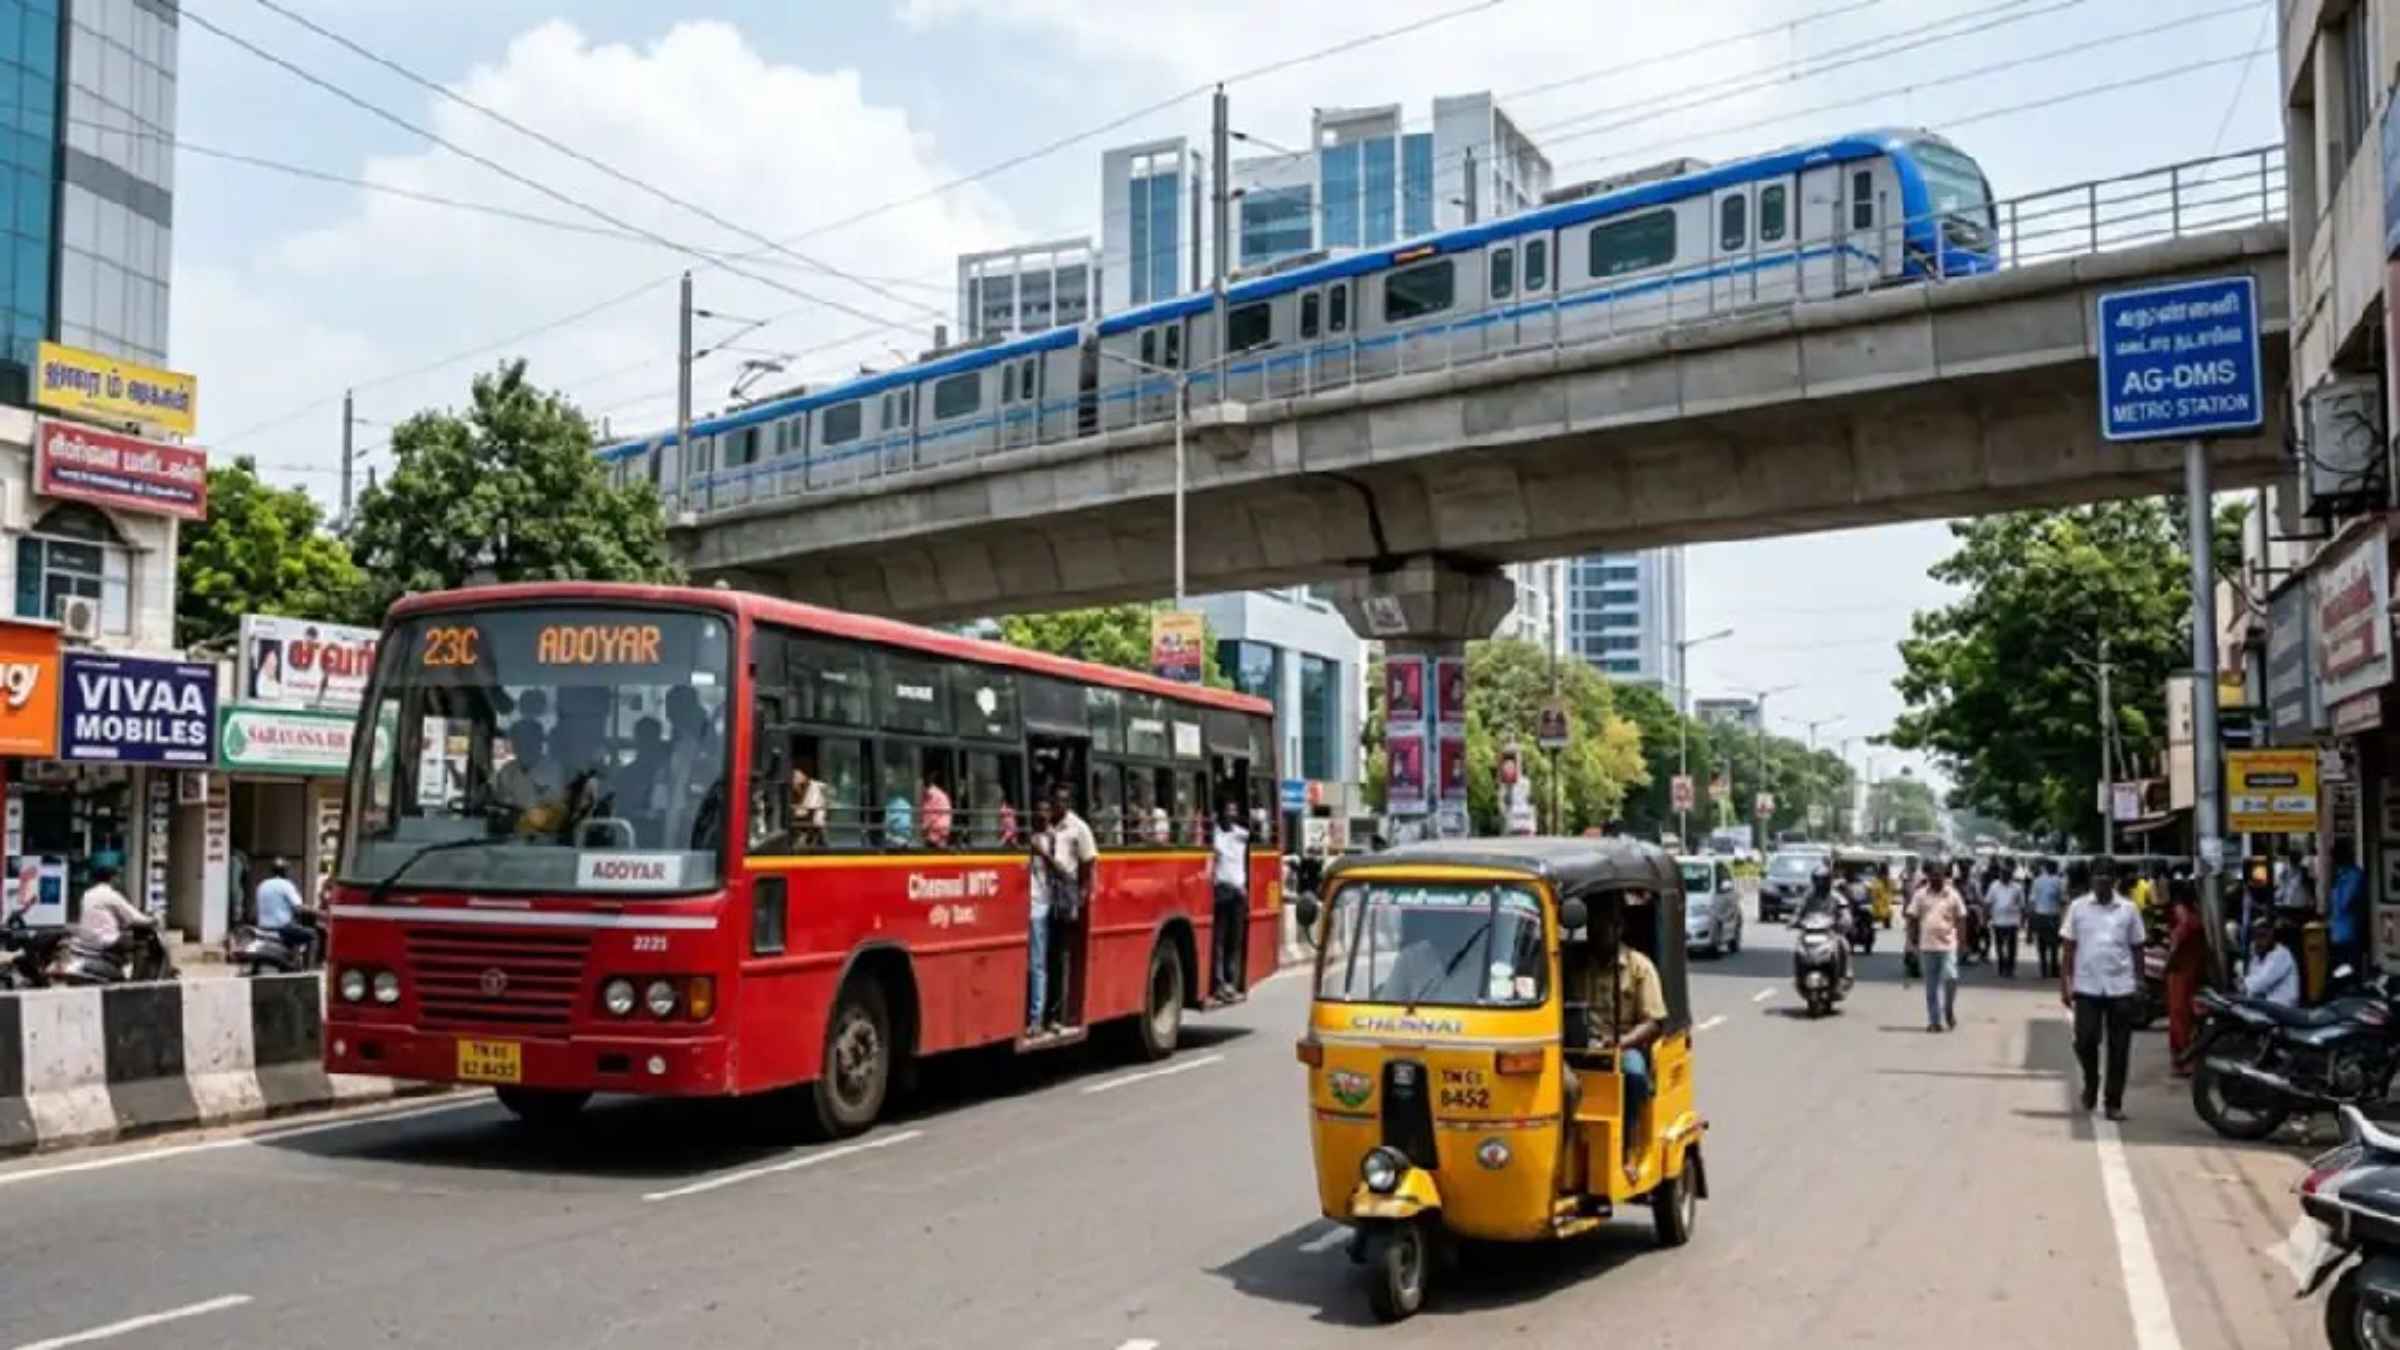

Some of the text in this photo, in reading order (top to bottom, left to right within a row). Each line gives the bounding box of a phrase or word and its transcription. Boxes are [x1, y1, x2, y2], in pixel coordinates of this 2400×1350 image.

[2122, 359, 2237, 395] AG-DMS
[2113, 393, 2249, 423] METRO STATION
[424, 625, 662, 666] 23C ADOYAR
[76, 673, 207, 716] VIVAA
[75, 713, 207, 746] MOBILES
[592, 861, 666, 880] ADOYAR
